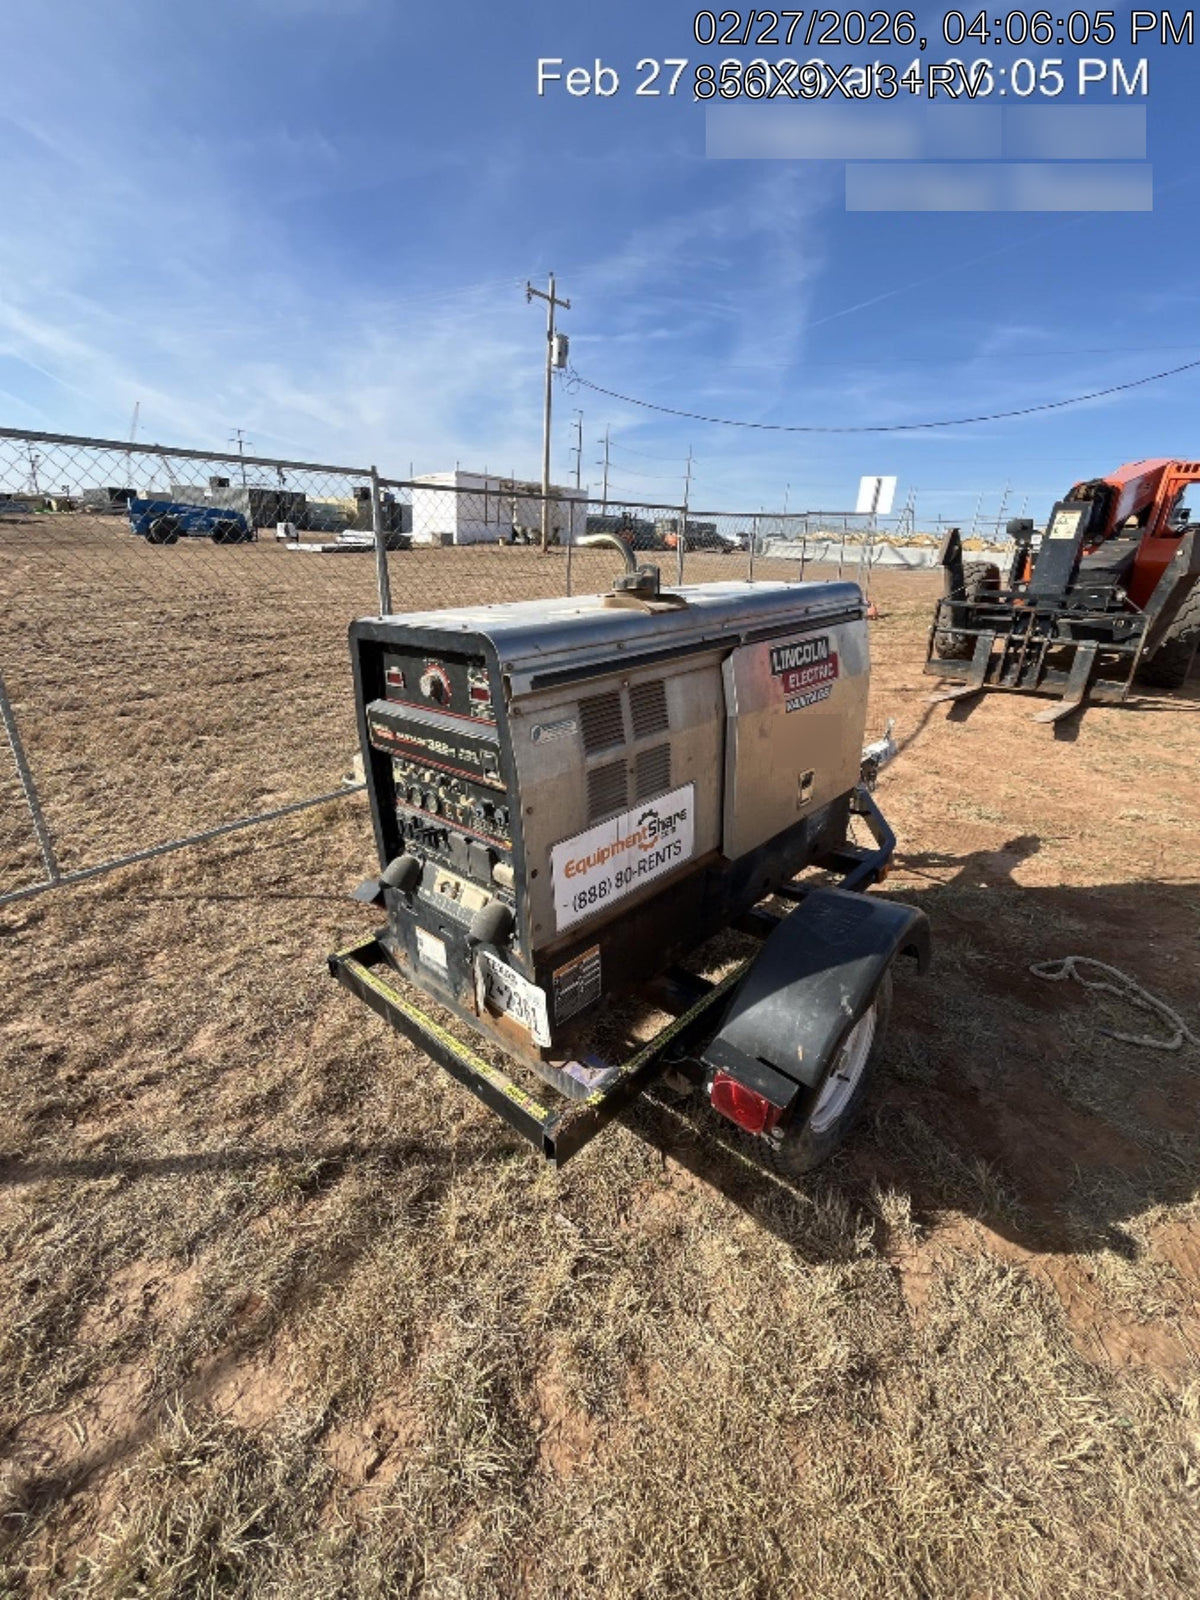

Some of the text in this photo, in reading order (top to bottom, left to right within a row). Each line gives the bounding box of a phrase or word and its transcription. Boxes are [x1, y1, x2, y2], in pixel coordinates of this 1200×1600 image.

[773, 639, 828, 672] LINCOLN
[788, 662, 835, 689] ELECTRIC
[564, 808, 688, 879] EquipmentShare
[572, 877, 613, 913] (888)
[614, 839, 683, 889] 80-RENTS
